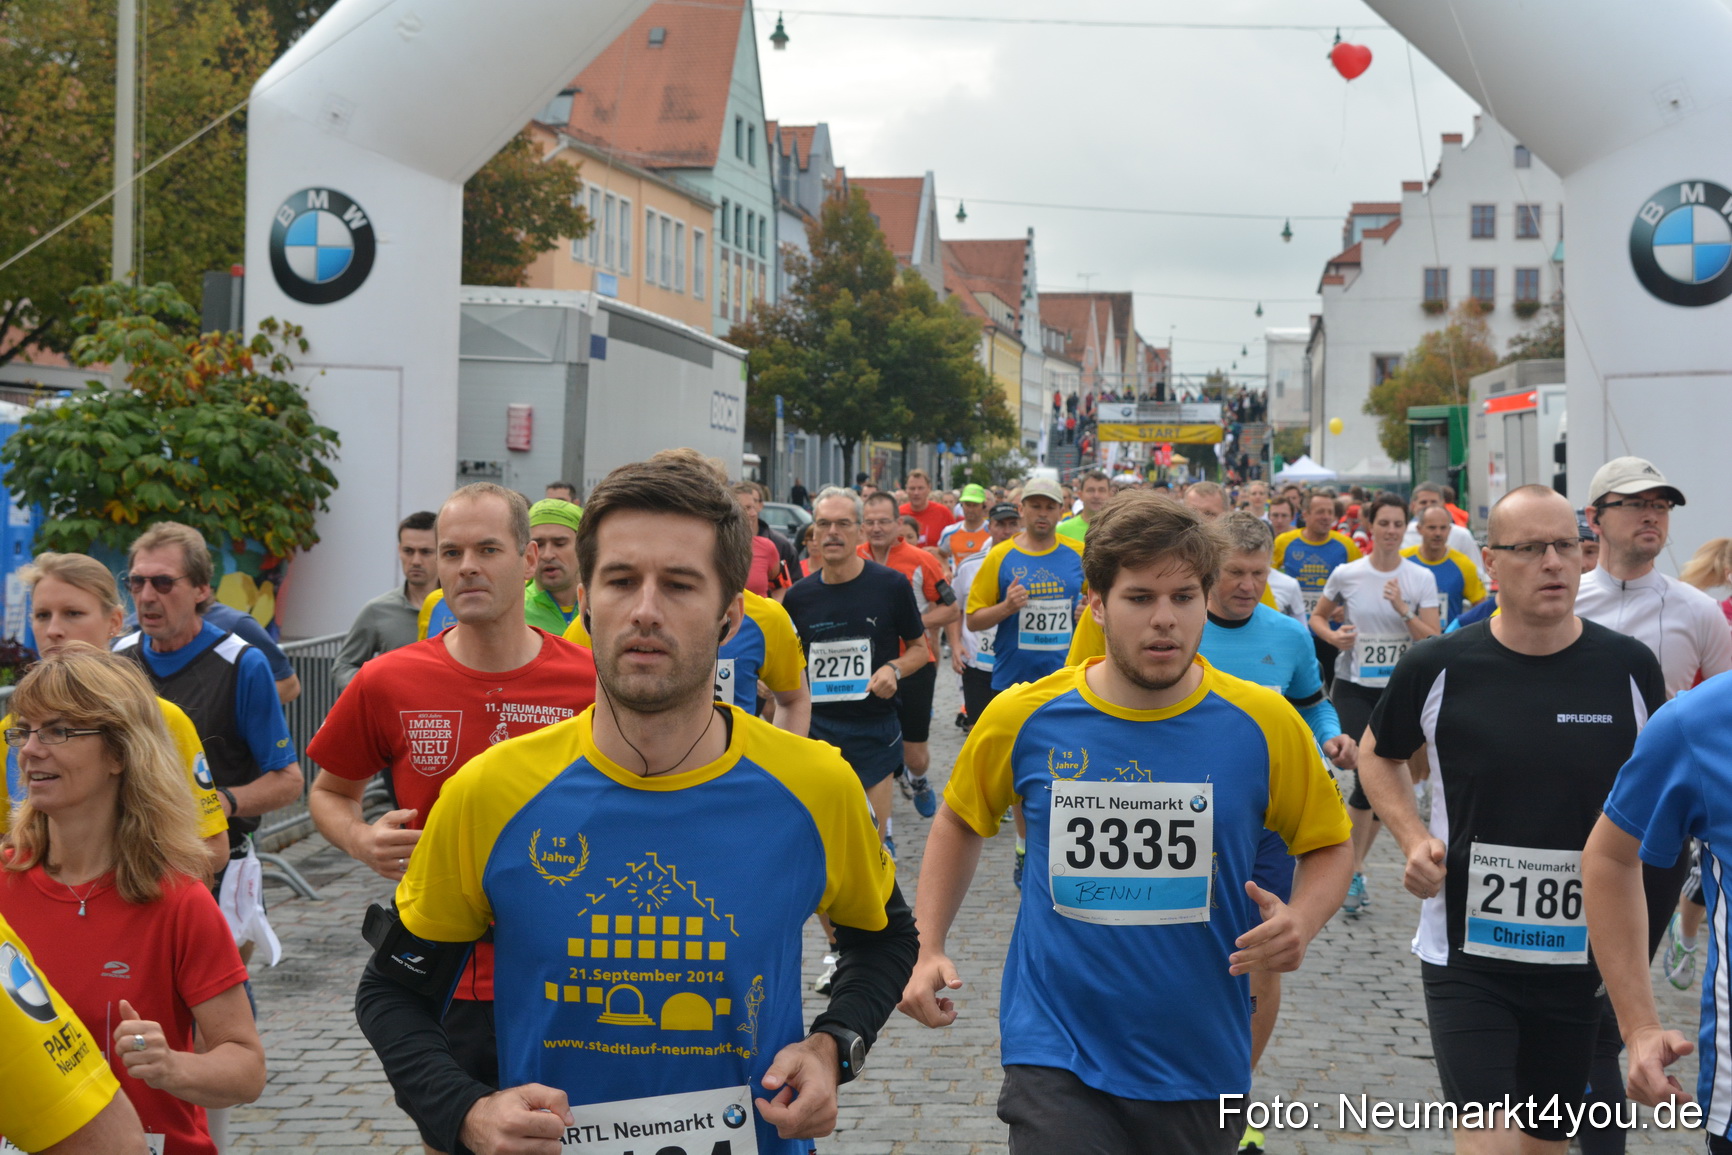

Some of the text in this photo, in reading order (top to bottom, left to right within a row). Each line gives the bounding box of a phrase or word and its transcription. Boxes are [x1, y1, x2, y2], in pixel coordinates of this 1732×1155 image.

[277, 189, 368, 231] BMW
[1138, 427, 1181, 439] START
[1025, 612, 1067, 631] 2872
[1034, 635, 1058, 643] Robert
[829, 646, 858, 654] Neumarkt
[814, 655, 864, 678] 2276
[826, 684, 854, 693] Werner
[485, 703, 574, 718] 11. NEUMARKTER
[409, 719, 451, 729] IMMER
[1565, 714, 1613, 723] PFLEIDERER
[408, 730, 452, 739] WIEDER
[411, 740, 449, 754] NEU
[412, 755, 448, 765] MARKT
[1054, 796, 1184, 811] PARTL Neumarkt
[551, 836, 566, 847] 15
[1066, 817, 1197, 870] 3335
[541, 851, 576, 864] Jahre
[1473, 854, 1576, 873] PARTL Neumarkt
[1075, 880, 1152, 904] BENNI
[1480, 873, 1582, 920] 2186
[1493, 926, 1565, 948] Christian
[404, 962, 427, 975] TOUCH
[569, 967, 725, 984] 21.September 2014
[543, 1037, 750, 1060] www.stadtlauf-neumarkt.de
[613, 1112, 715, 1140] Neumarkt
